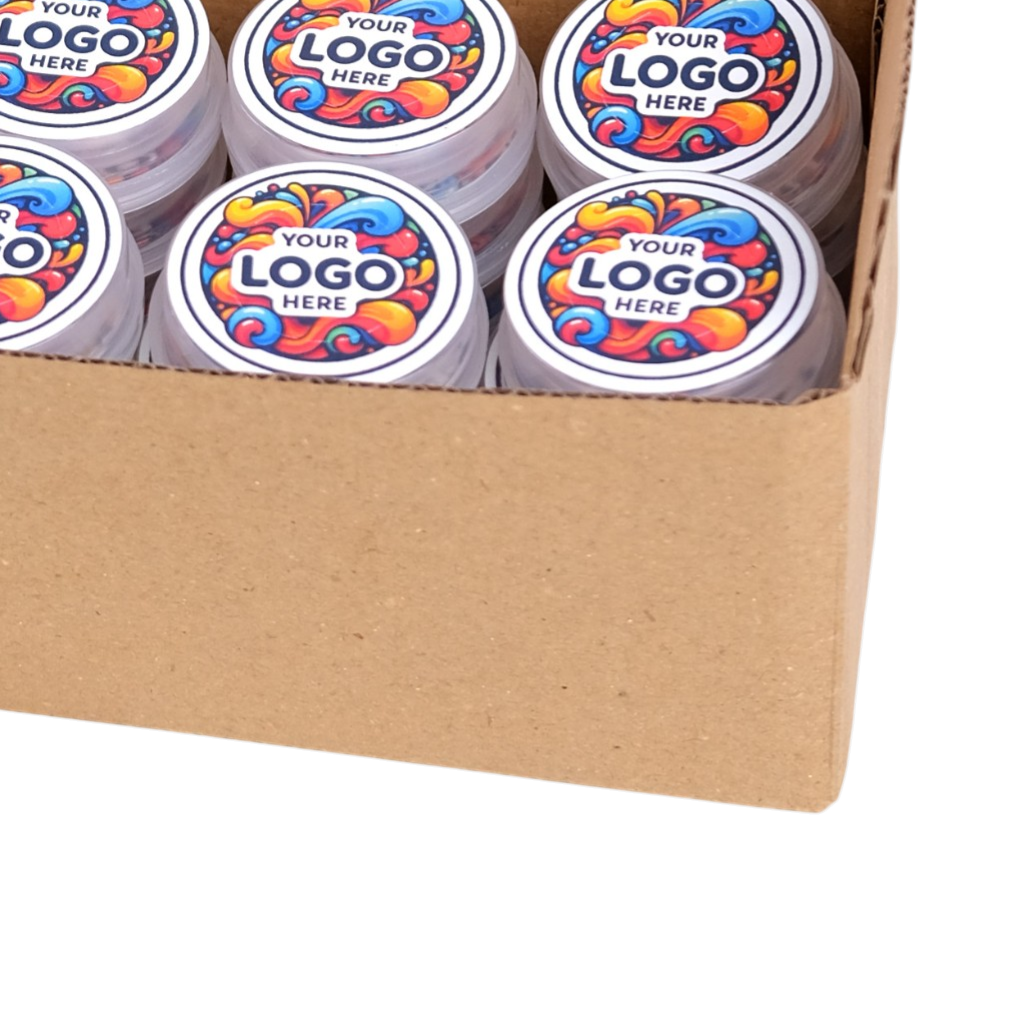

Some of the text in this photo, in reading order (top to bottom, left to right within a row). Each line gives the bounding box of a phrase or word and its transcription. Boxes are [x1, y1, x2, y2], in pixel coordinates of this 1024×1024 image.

[41, 1, 102, 19] YOUR
[347, 16, 408, 34] YOUR
[655, 31, 718, 49] YOUR
[298, 32, 444, 73] LOGO
[29, 54, 89, 72] HERE
[331, 68, 391, 87] HERE
[609, 53, 759, 93] LOGO
[645, 94, 707, 112] HERE
[282, 233, 348, 249] YOUR
[629, 238, 696, 257] YOUR
[241, 254, 397, 292] LOGO
[578, 257, 737, 299] LOGO
[283, 294, 346, 311] HERE
[615, 297, 680, 316] HERE
